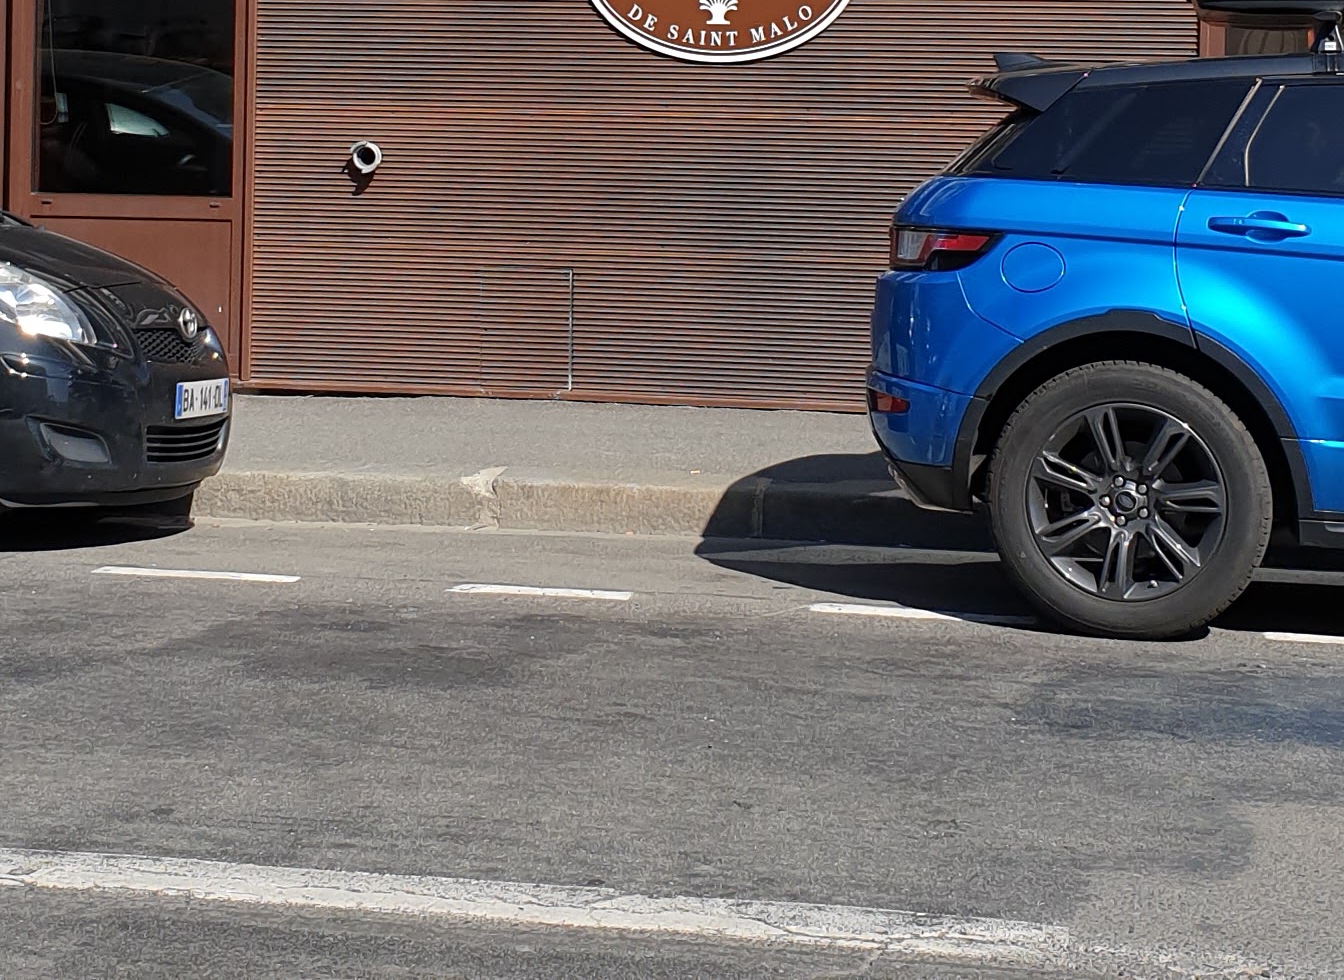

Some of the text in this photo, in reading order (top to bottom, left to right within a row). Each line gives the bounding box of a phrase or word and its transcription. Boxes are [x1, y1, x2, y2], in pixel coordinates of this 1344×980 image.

[627, 3, 813, 47] DE SAINT MALO
